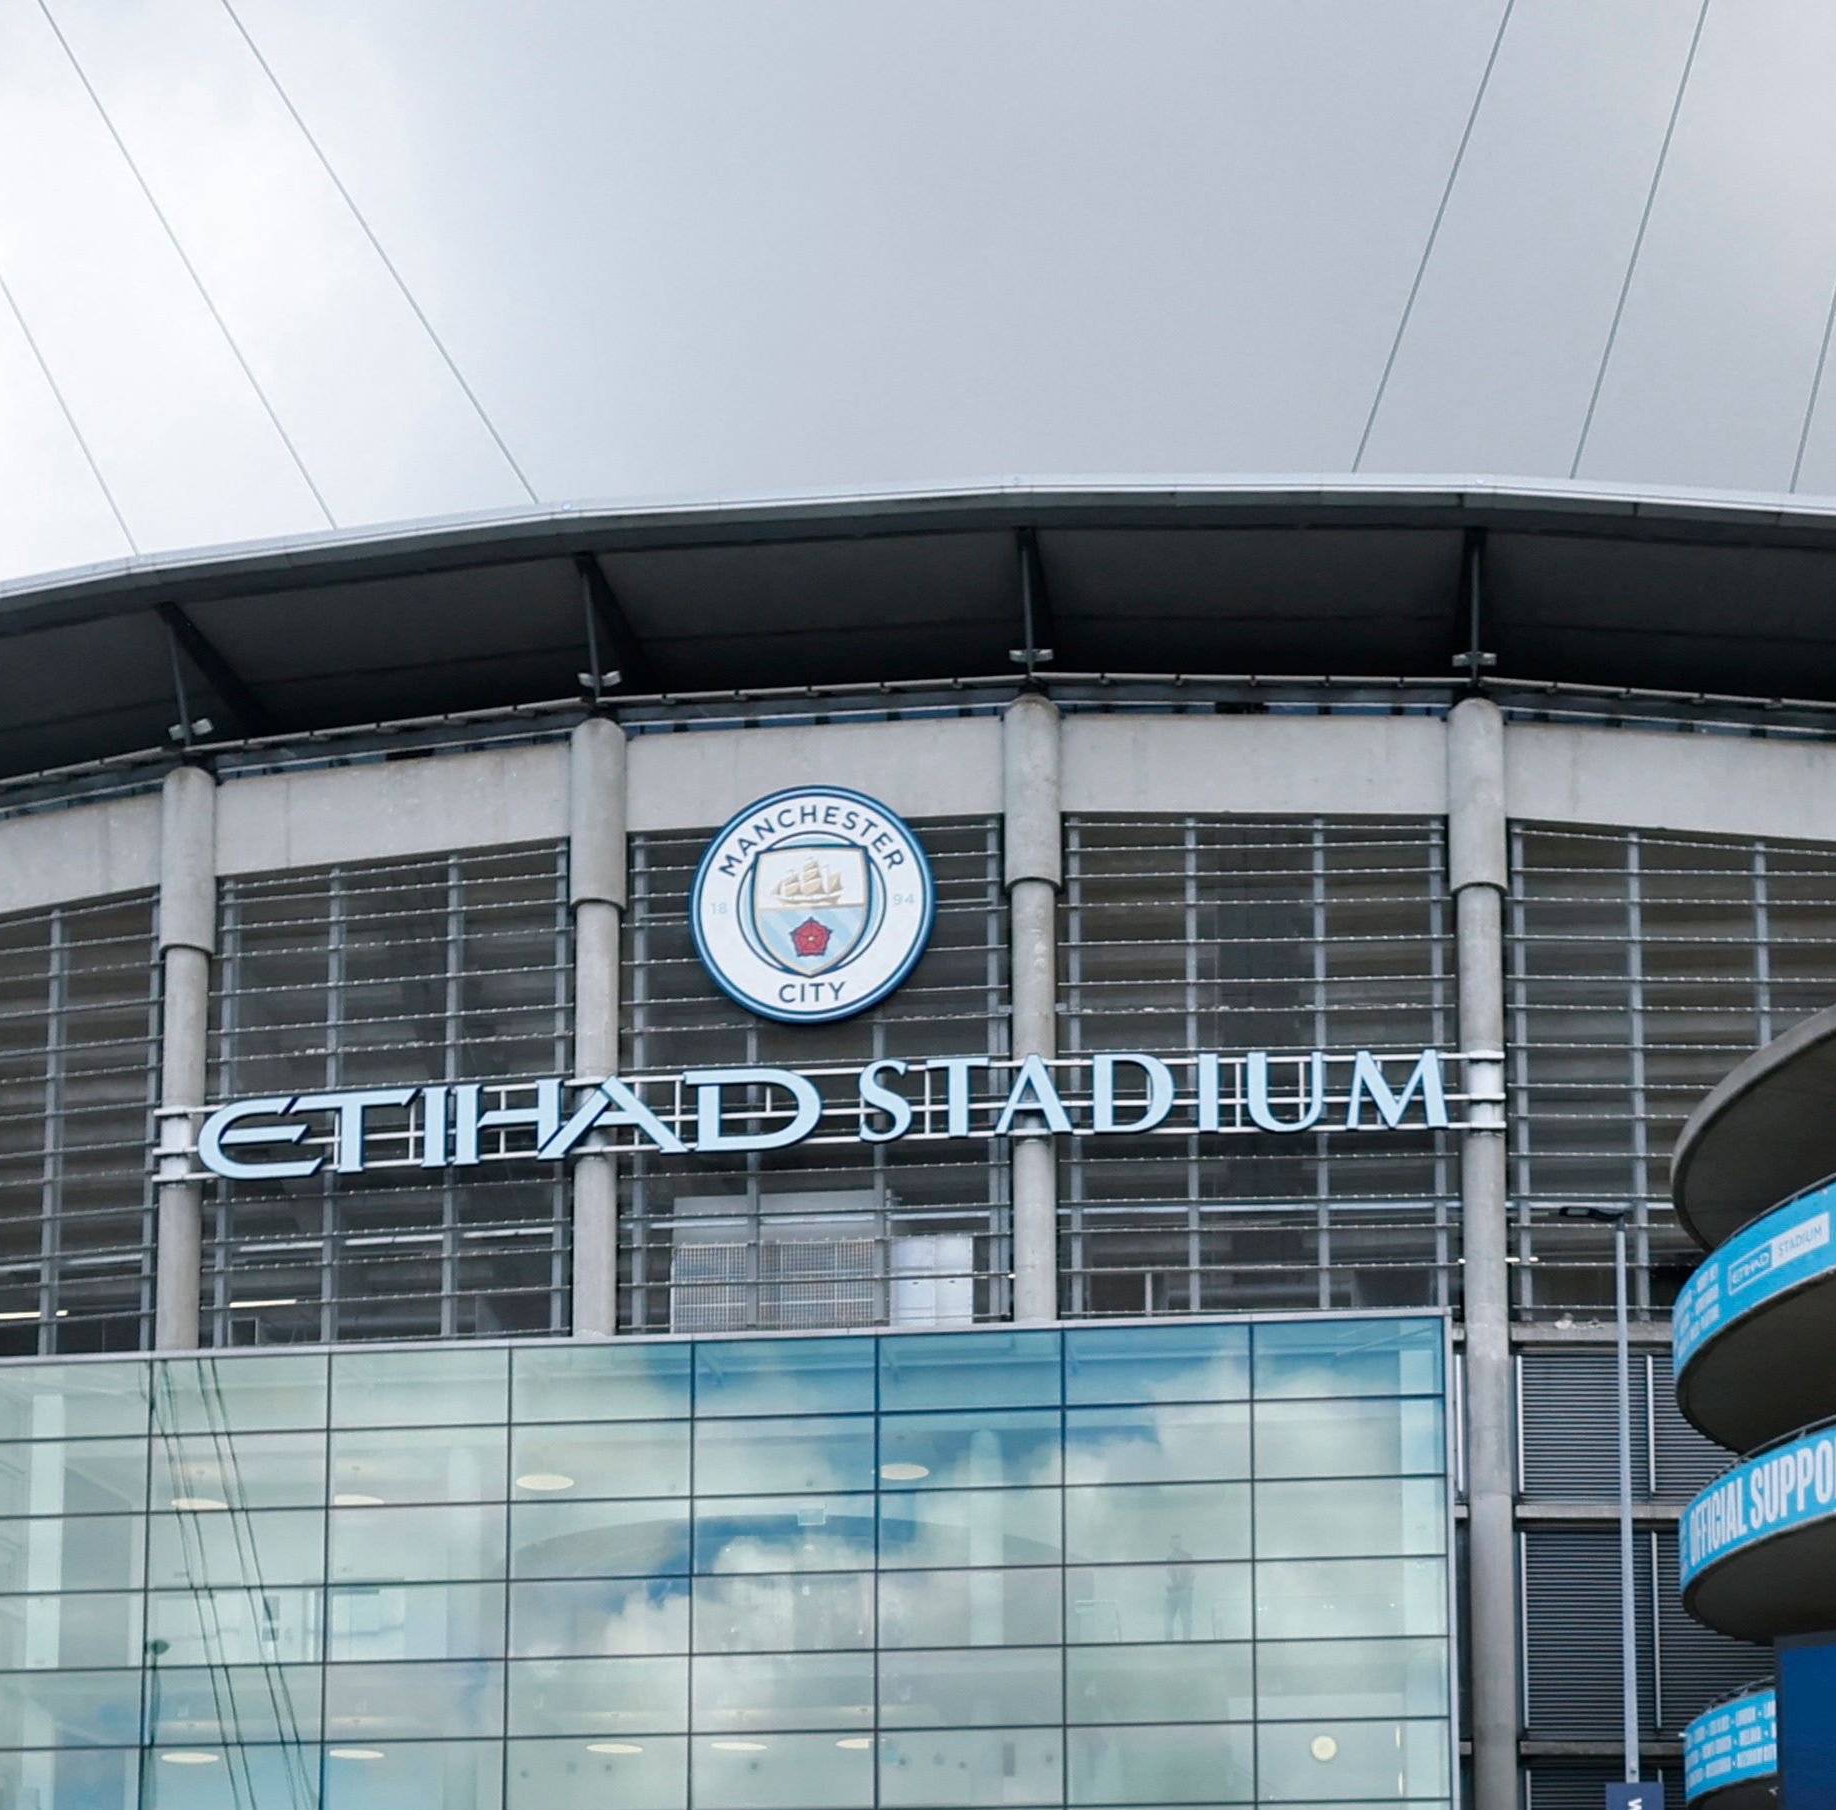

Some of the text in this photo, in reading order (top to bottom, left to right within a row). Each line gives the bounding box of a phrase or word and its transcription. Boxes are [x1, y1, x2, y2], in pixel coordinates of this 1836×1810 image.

[718, 805, 904, 877] MANCHESTER
[711, 894, 914, 914] 18 94
[779, 981, 845, 1003] CITY
[198, 1049, 1449, 1180] ETIHAD STADIUM
[1778, 1223, 1823, 1256] STADIUM
